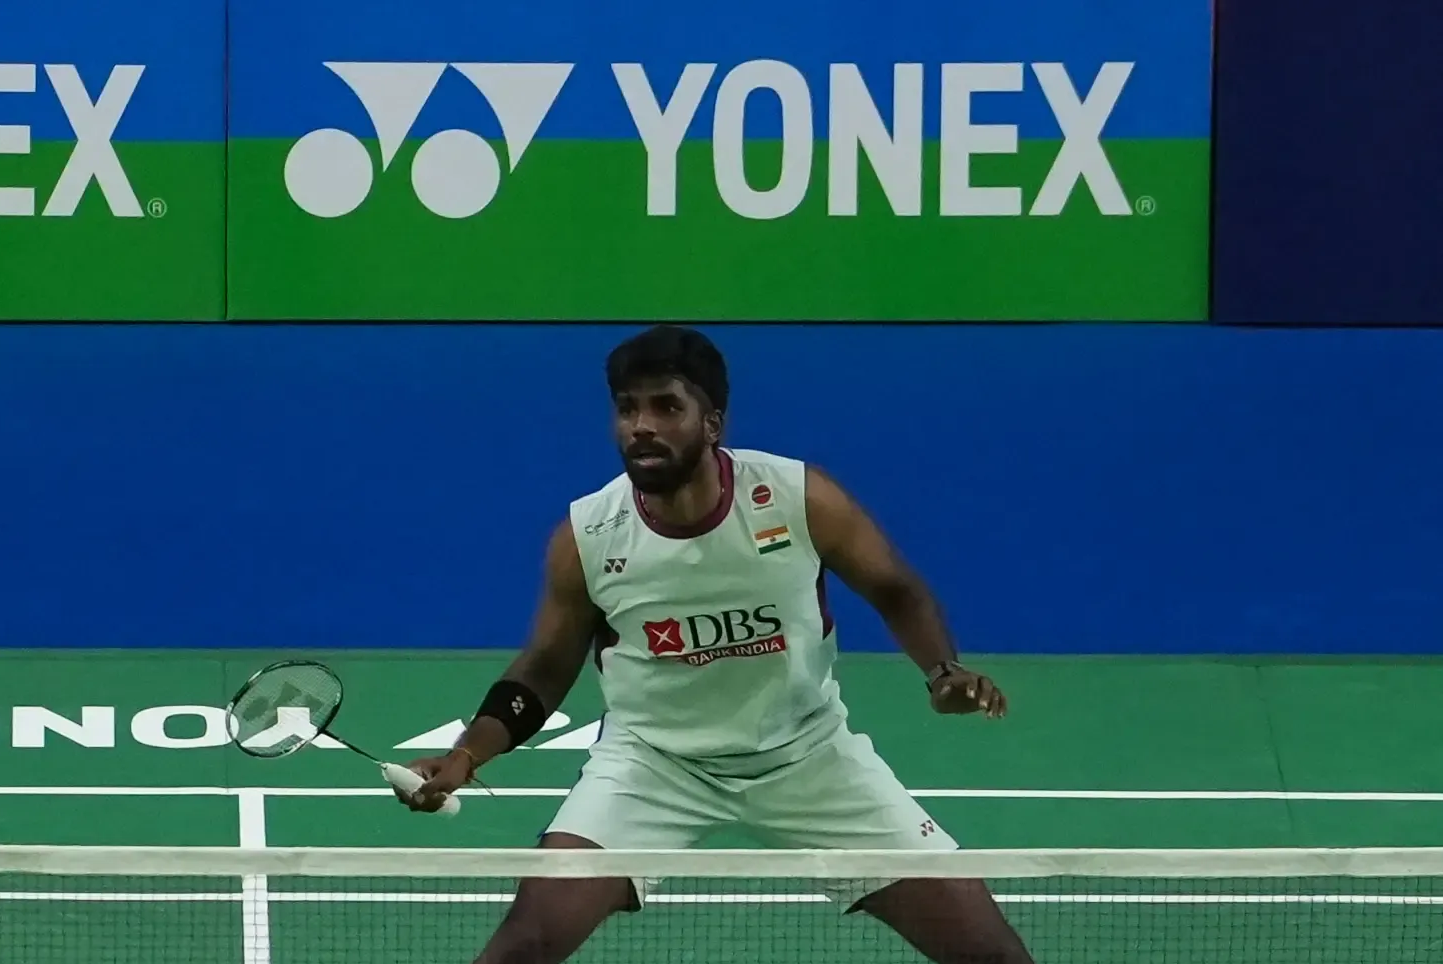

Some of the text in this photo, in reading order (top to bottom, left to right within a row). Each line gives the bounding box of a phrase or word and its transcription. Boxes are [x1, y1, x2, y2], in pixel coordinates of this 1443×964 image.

[610, 59, 1136, 219] YONEX
[685, 604, 783, 649] DBS
[688, 639, 782, 665] BANK INDIA
